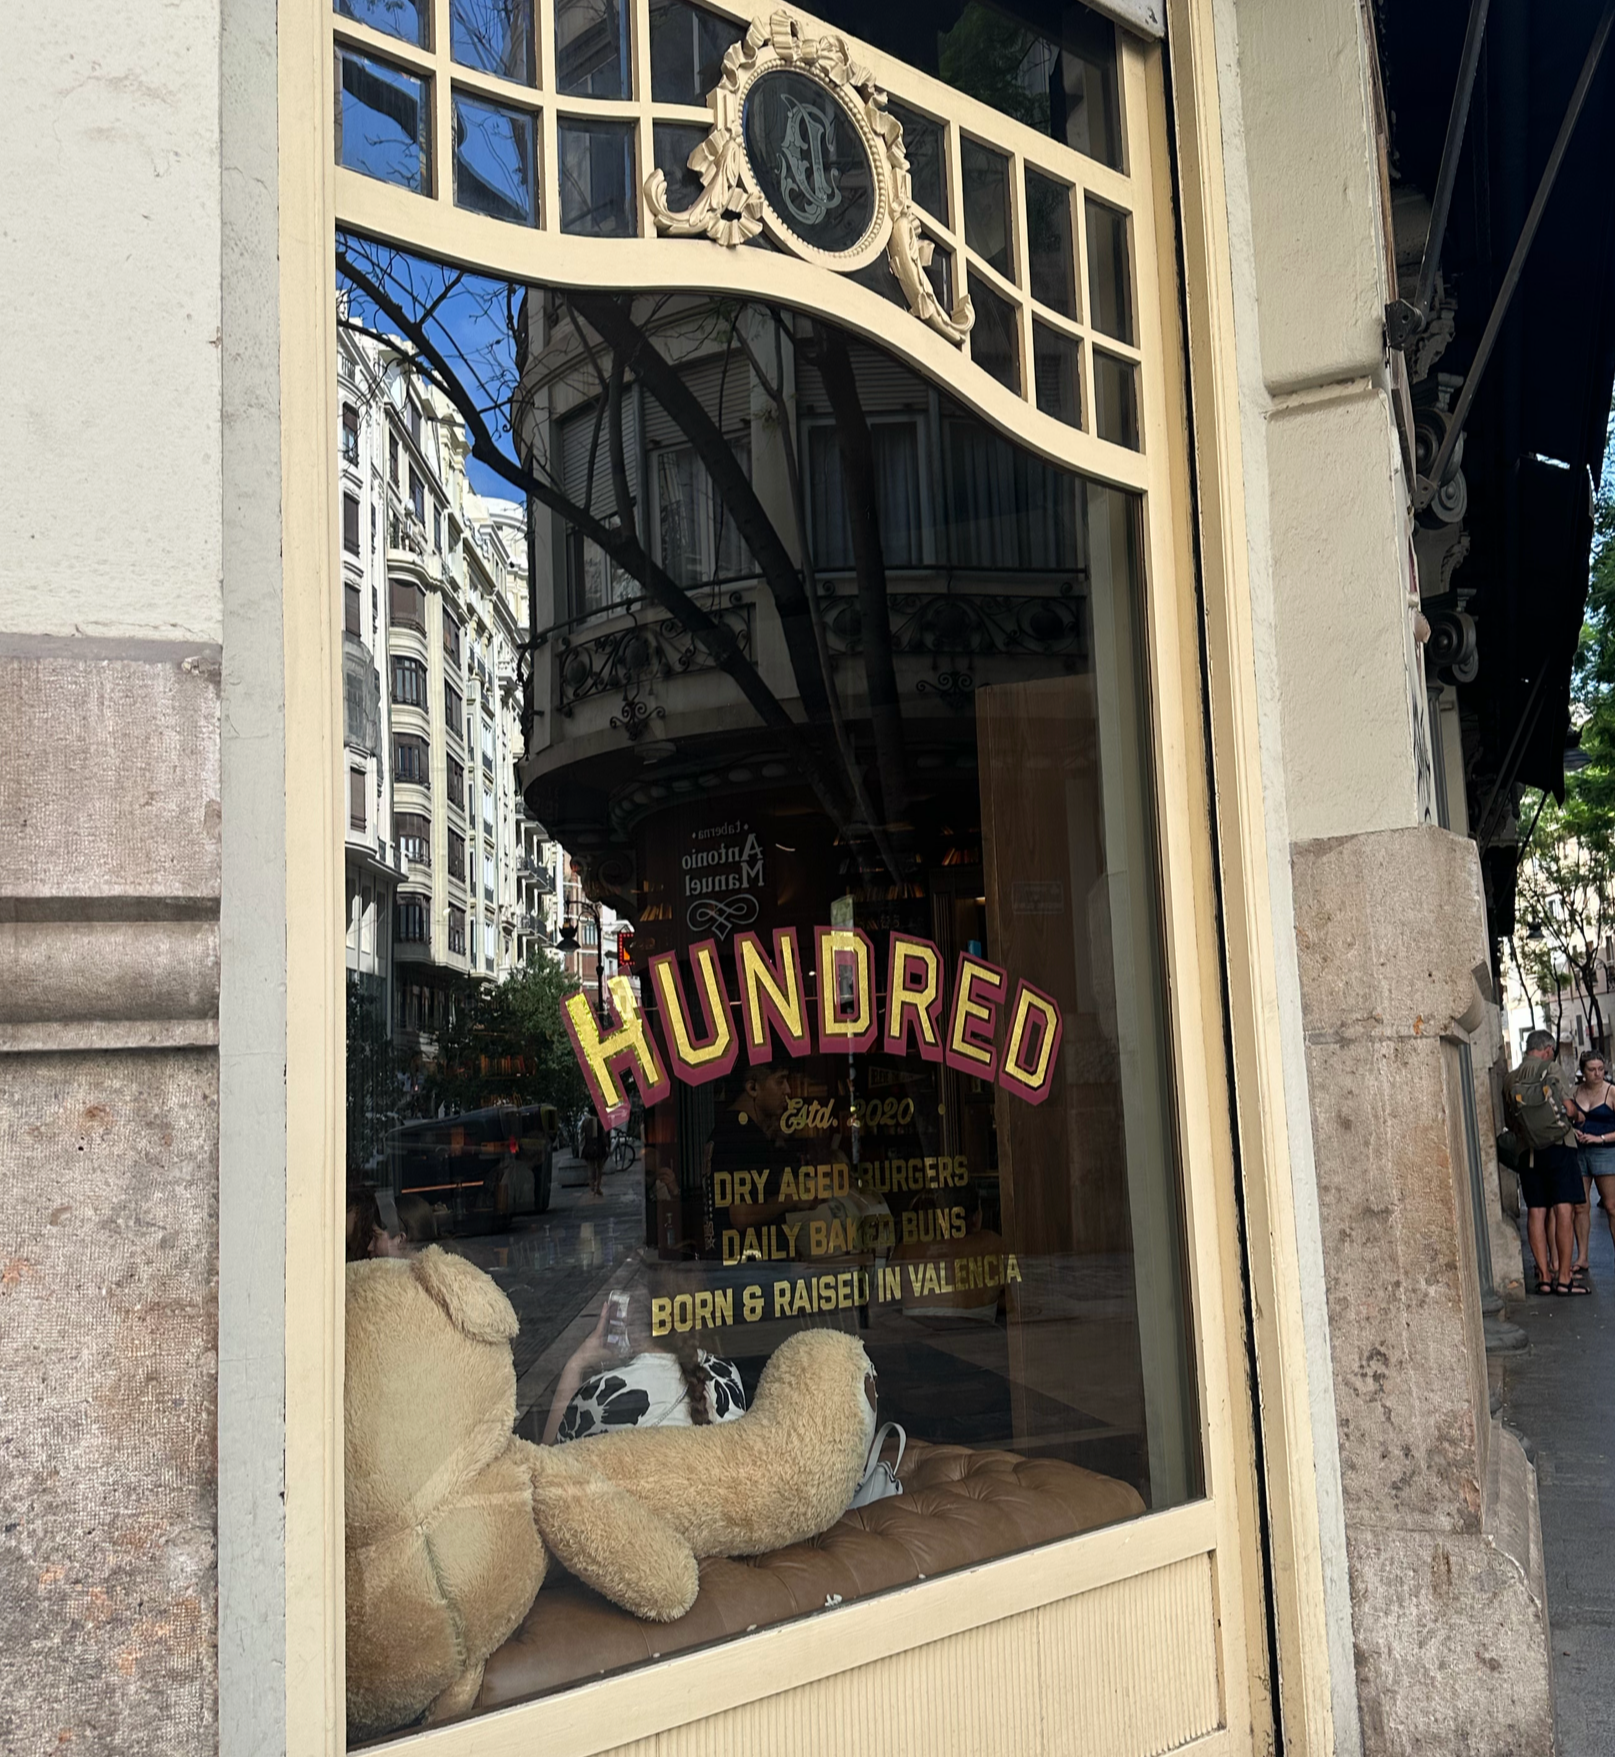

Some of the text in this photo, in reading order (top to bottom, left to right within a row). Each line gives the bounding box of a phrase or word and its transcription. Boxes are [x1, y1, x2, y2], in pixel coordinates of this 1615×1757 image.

[560, 925, 1064, 1131] HUNDRED
[780, 1097, 914, 1134] Estd. 2020
[714, 1155, 969, 1208] DRY AGED BURGERS
[721, 1224, 801, 1266] DAILY
[809, 1214, 894, 1255] BAKED
[902, 1206, 967, 1242] BUNS
[651, 1253, 1022, 1338] BORN & RAISED IN VALENCIA
